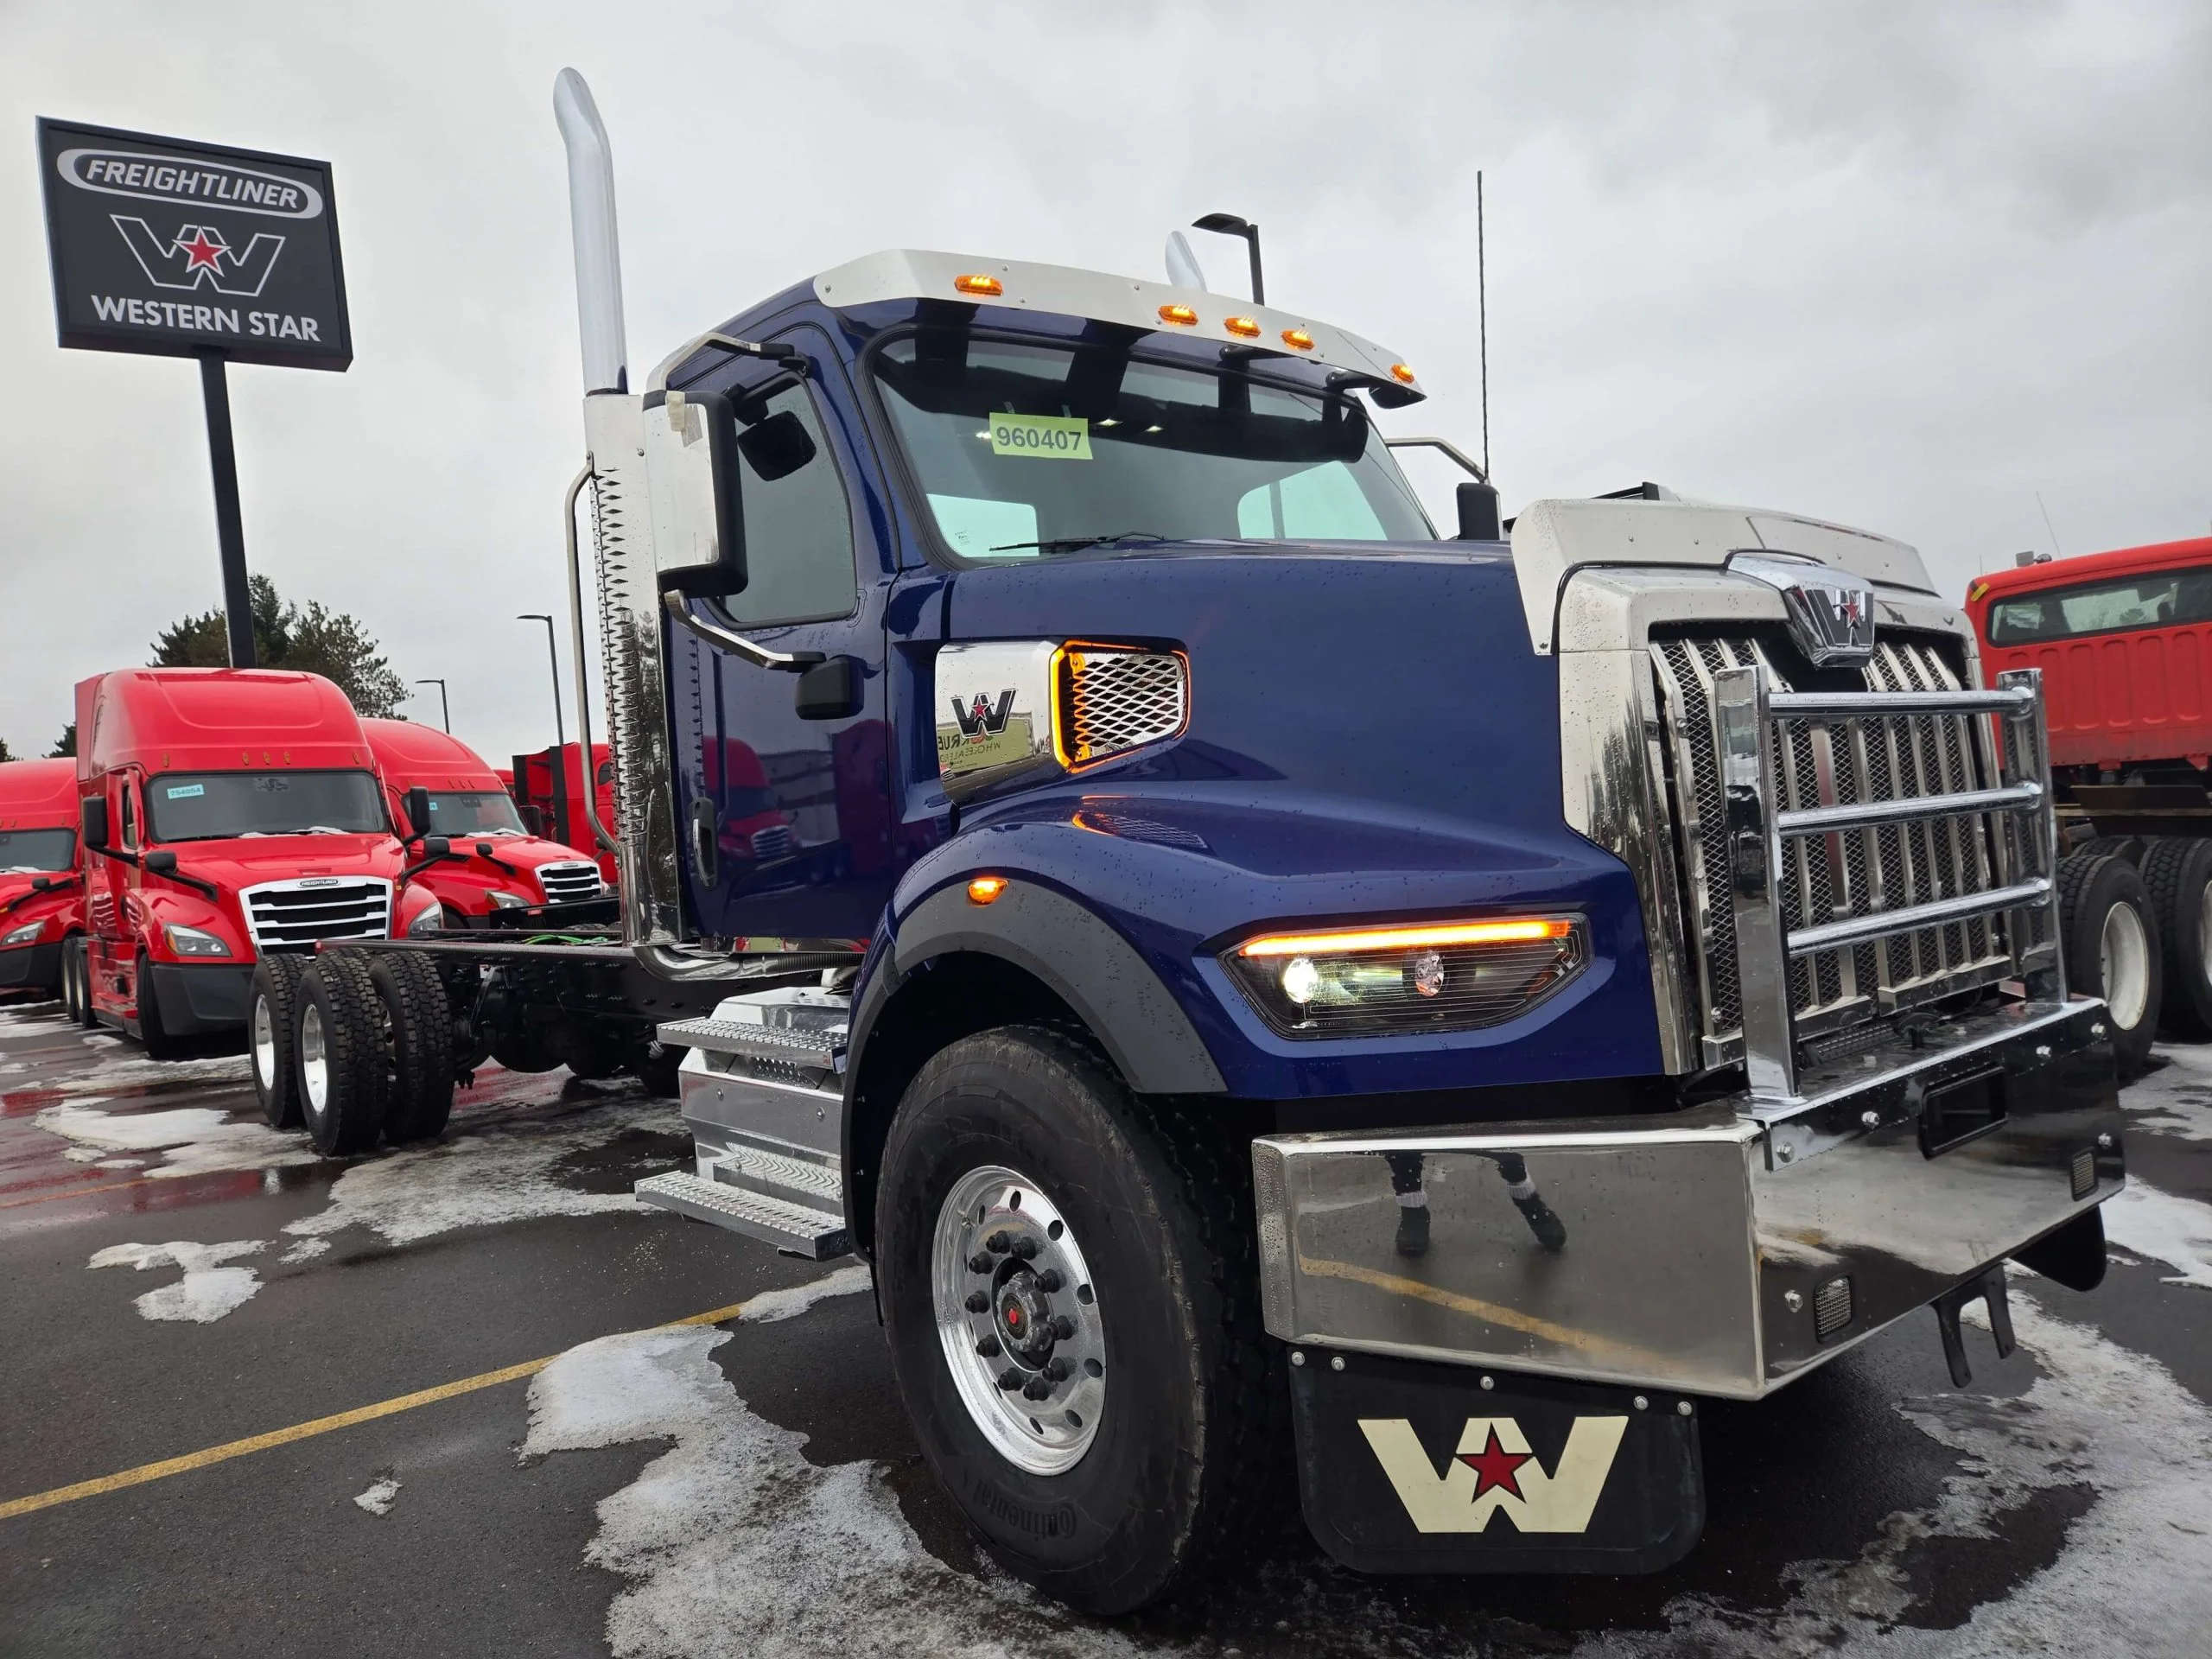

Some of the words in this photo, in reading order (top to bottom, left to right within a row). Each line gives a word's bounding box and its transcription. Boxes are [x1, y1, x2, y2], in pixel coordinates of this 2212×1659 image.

[86, 160, 297, 209] FREIGHTLINER
[91, 295, 240, 334] WESTERN
[249, 313, 321, 342] STAR
[996, 426, 1081, 450] 960407
